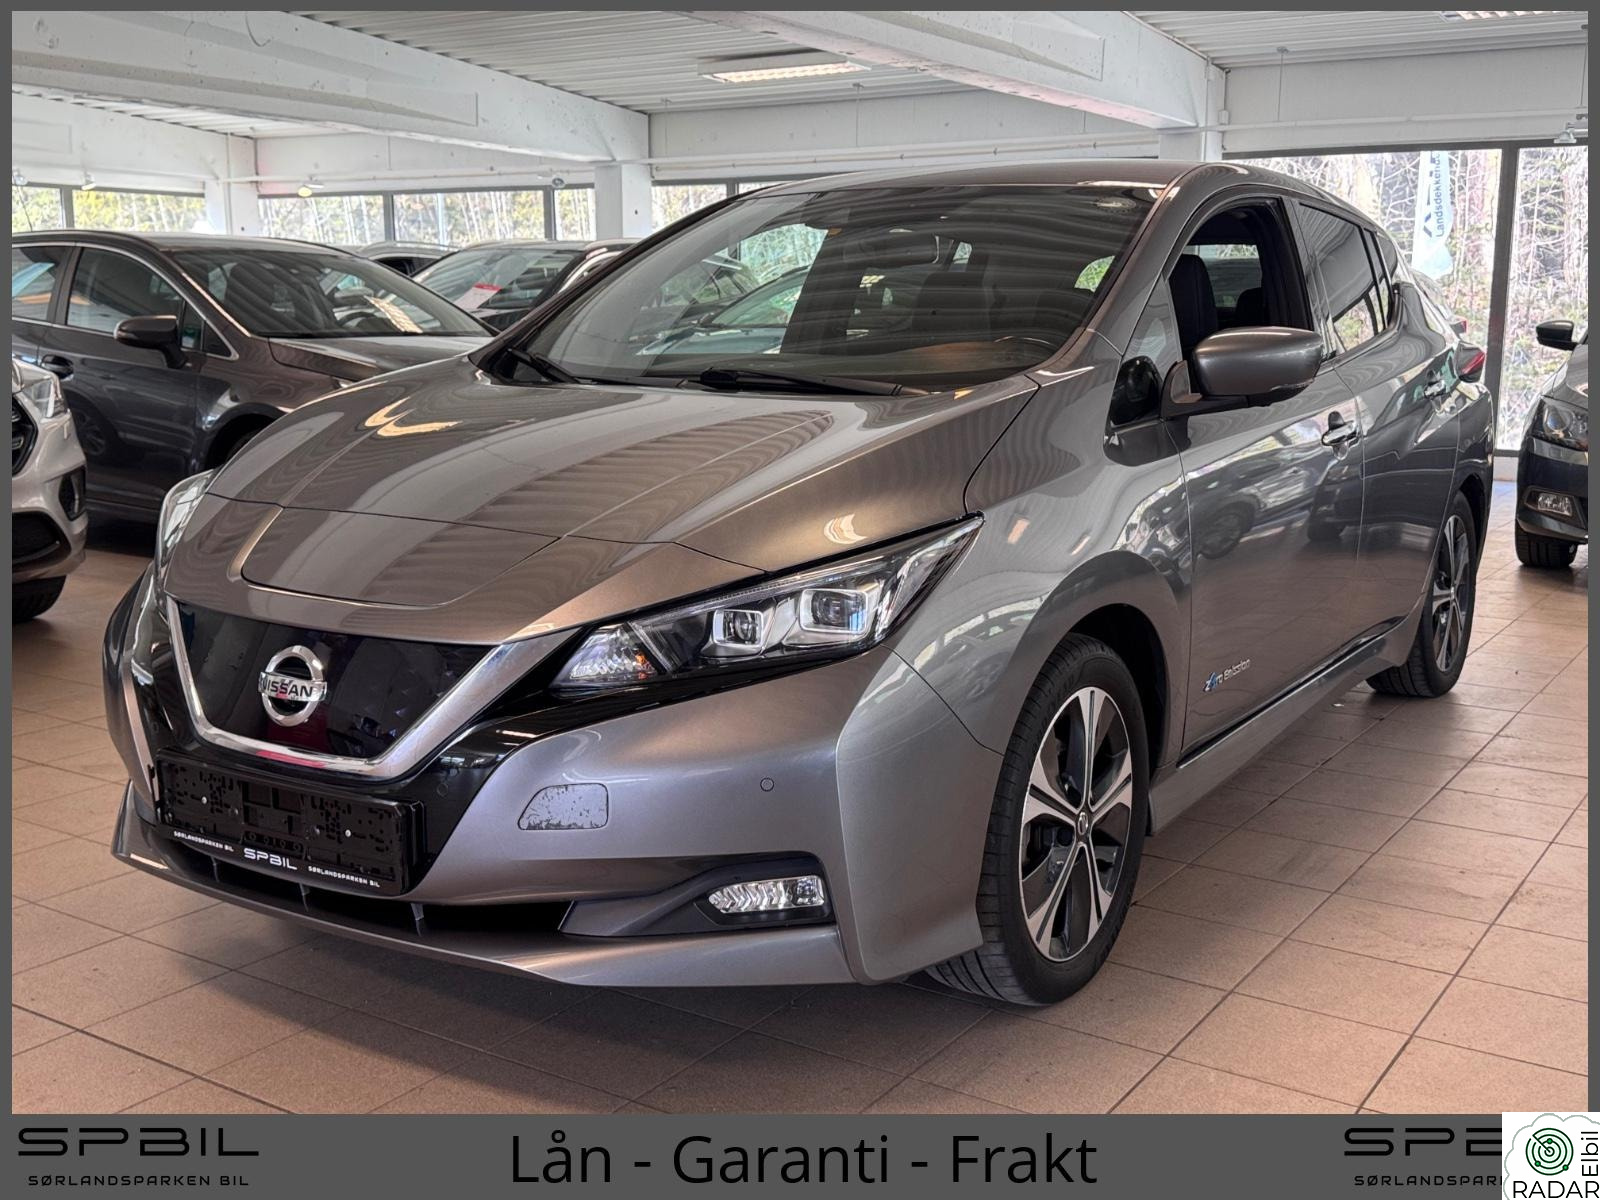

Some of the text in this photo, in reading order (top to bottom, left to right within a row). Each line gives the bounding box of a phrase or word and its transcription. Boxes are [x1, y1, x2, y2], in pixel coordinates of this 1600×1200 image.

[262, 678, 313, 698] NISSAN
[243, 847, 298, 870] SPBIL
[369, 879, 380, 888] BIL
